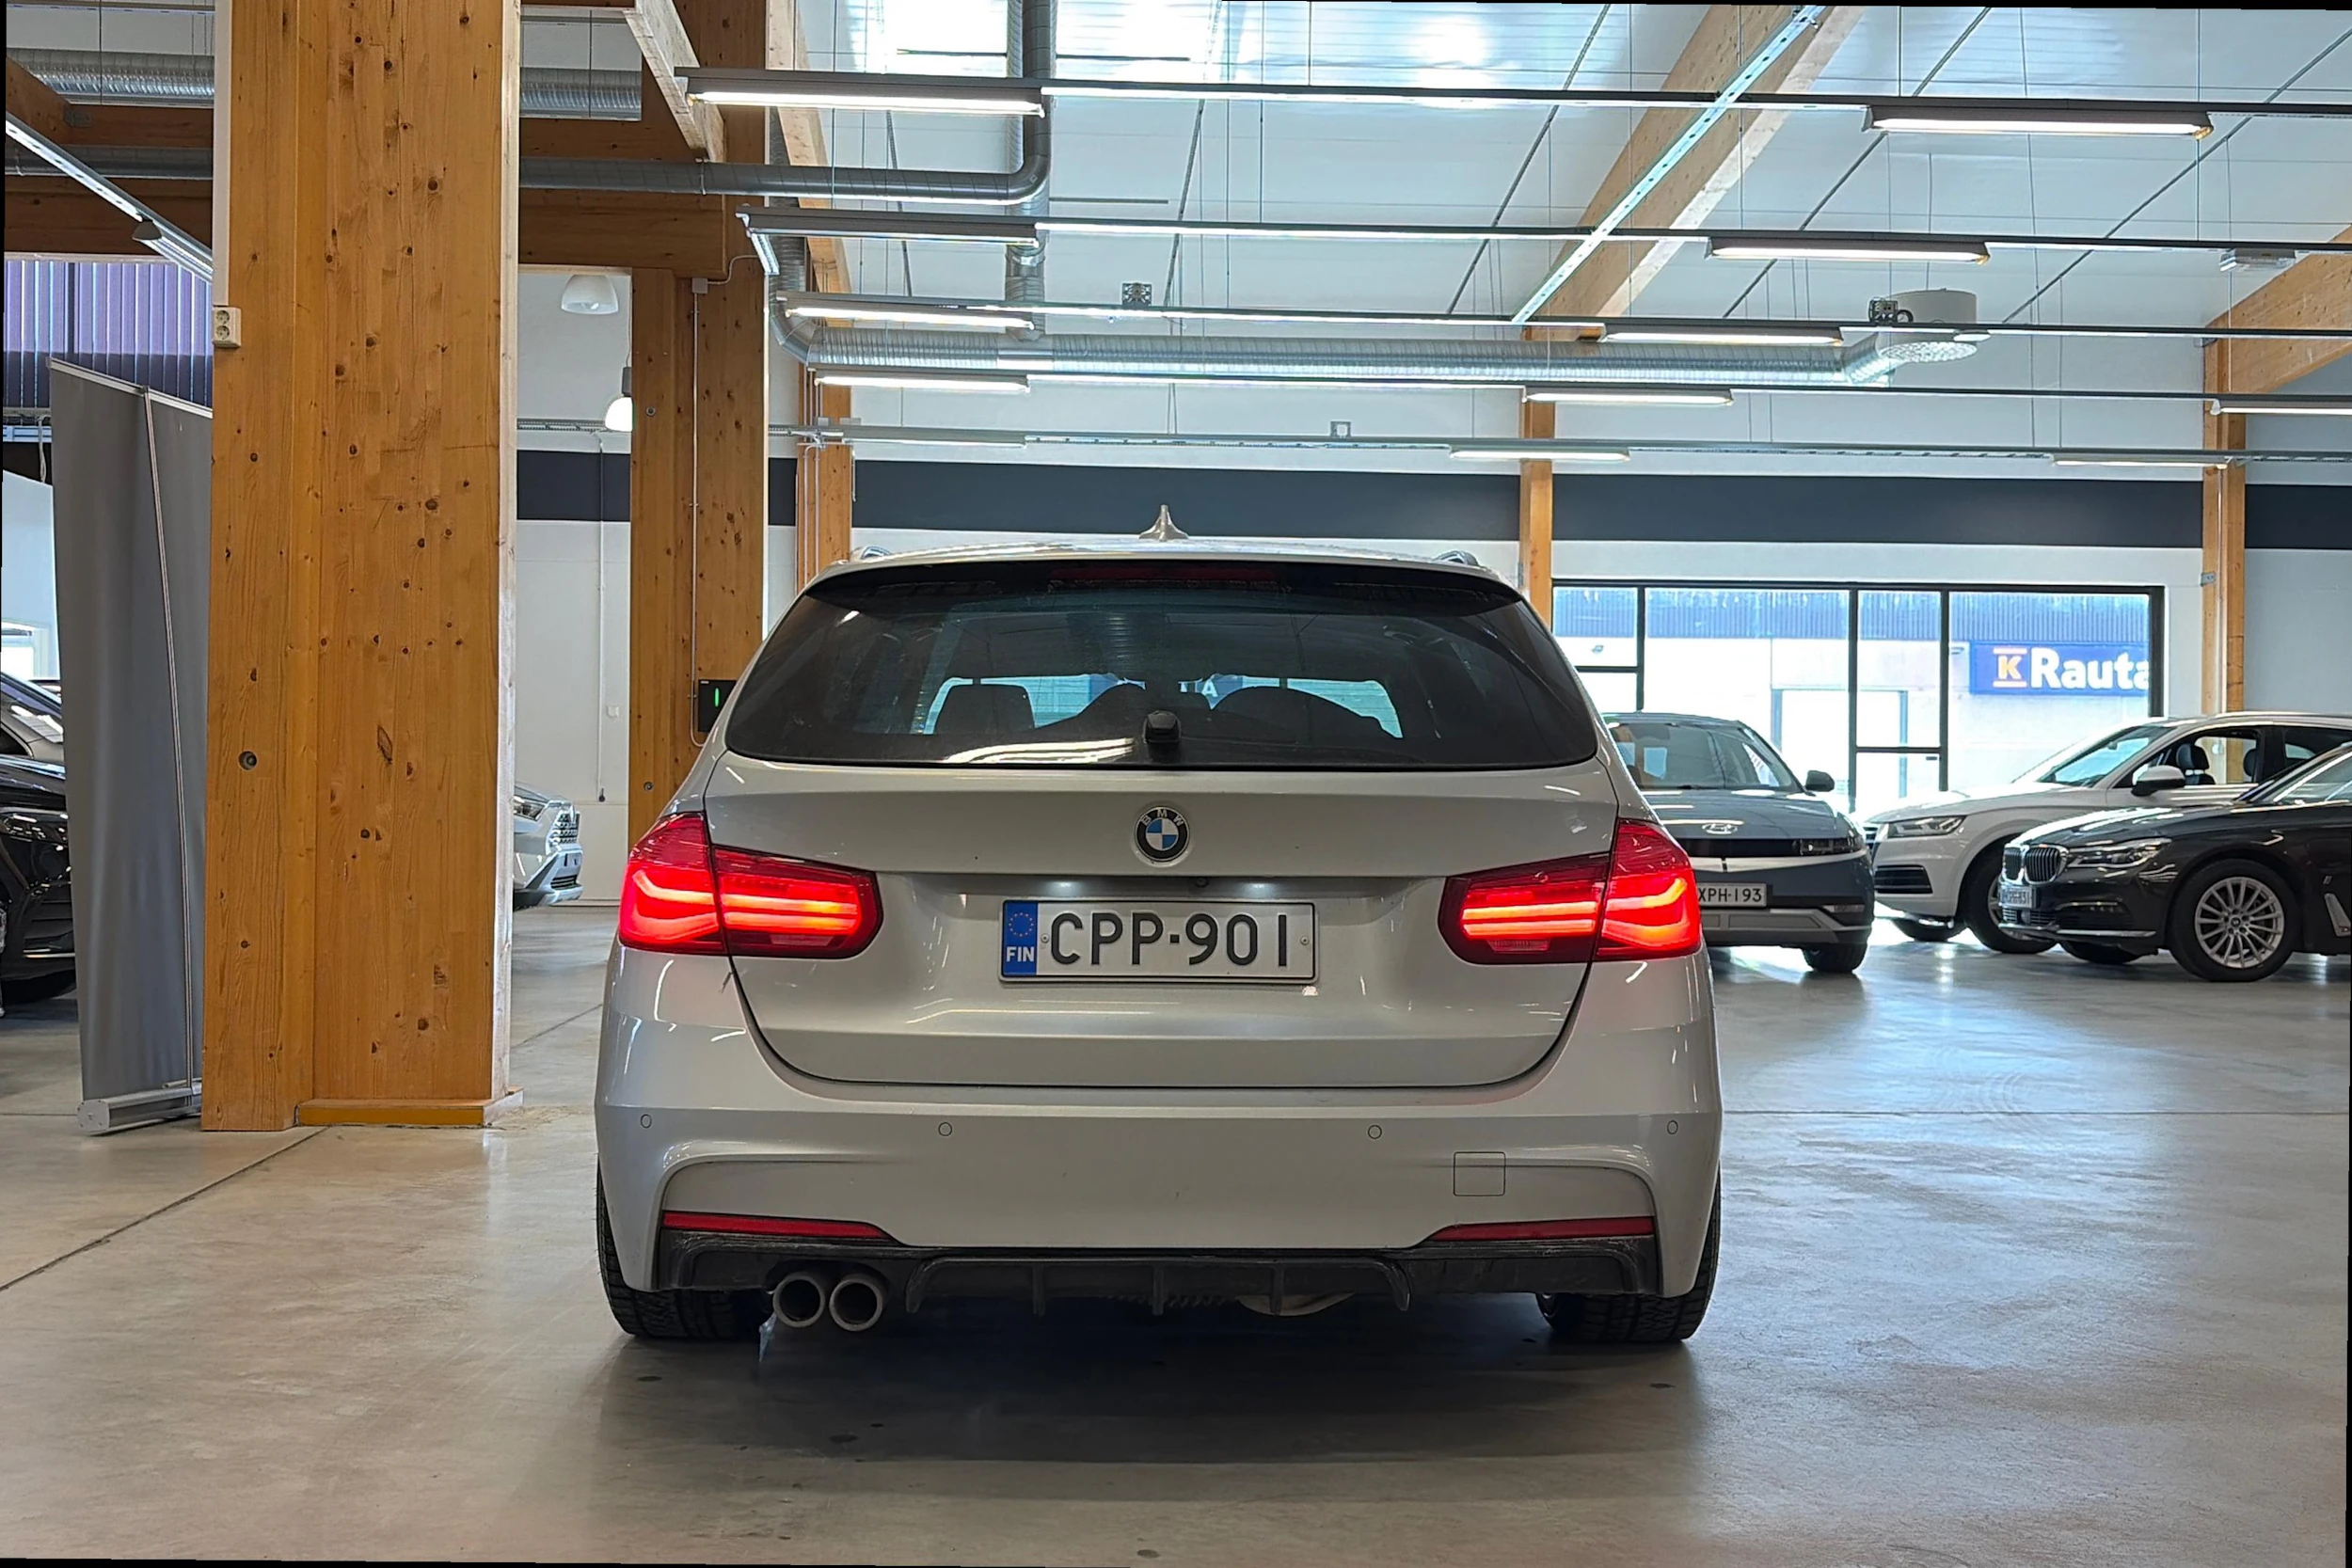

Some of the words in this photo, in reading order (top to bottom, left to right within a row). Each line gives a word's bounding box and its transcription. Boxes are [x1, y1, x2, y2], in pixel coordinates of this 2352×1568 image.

[1996, 655, 2022, 680] K
[1140, 809, 1184, 827] BMW
[1697, 887, 1762, 903] XPH-193
[1050, 911, 1288, 968] CPP-901
[1005, 945, 1035, 962] FIN
